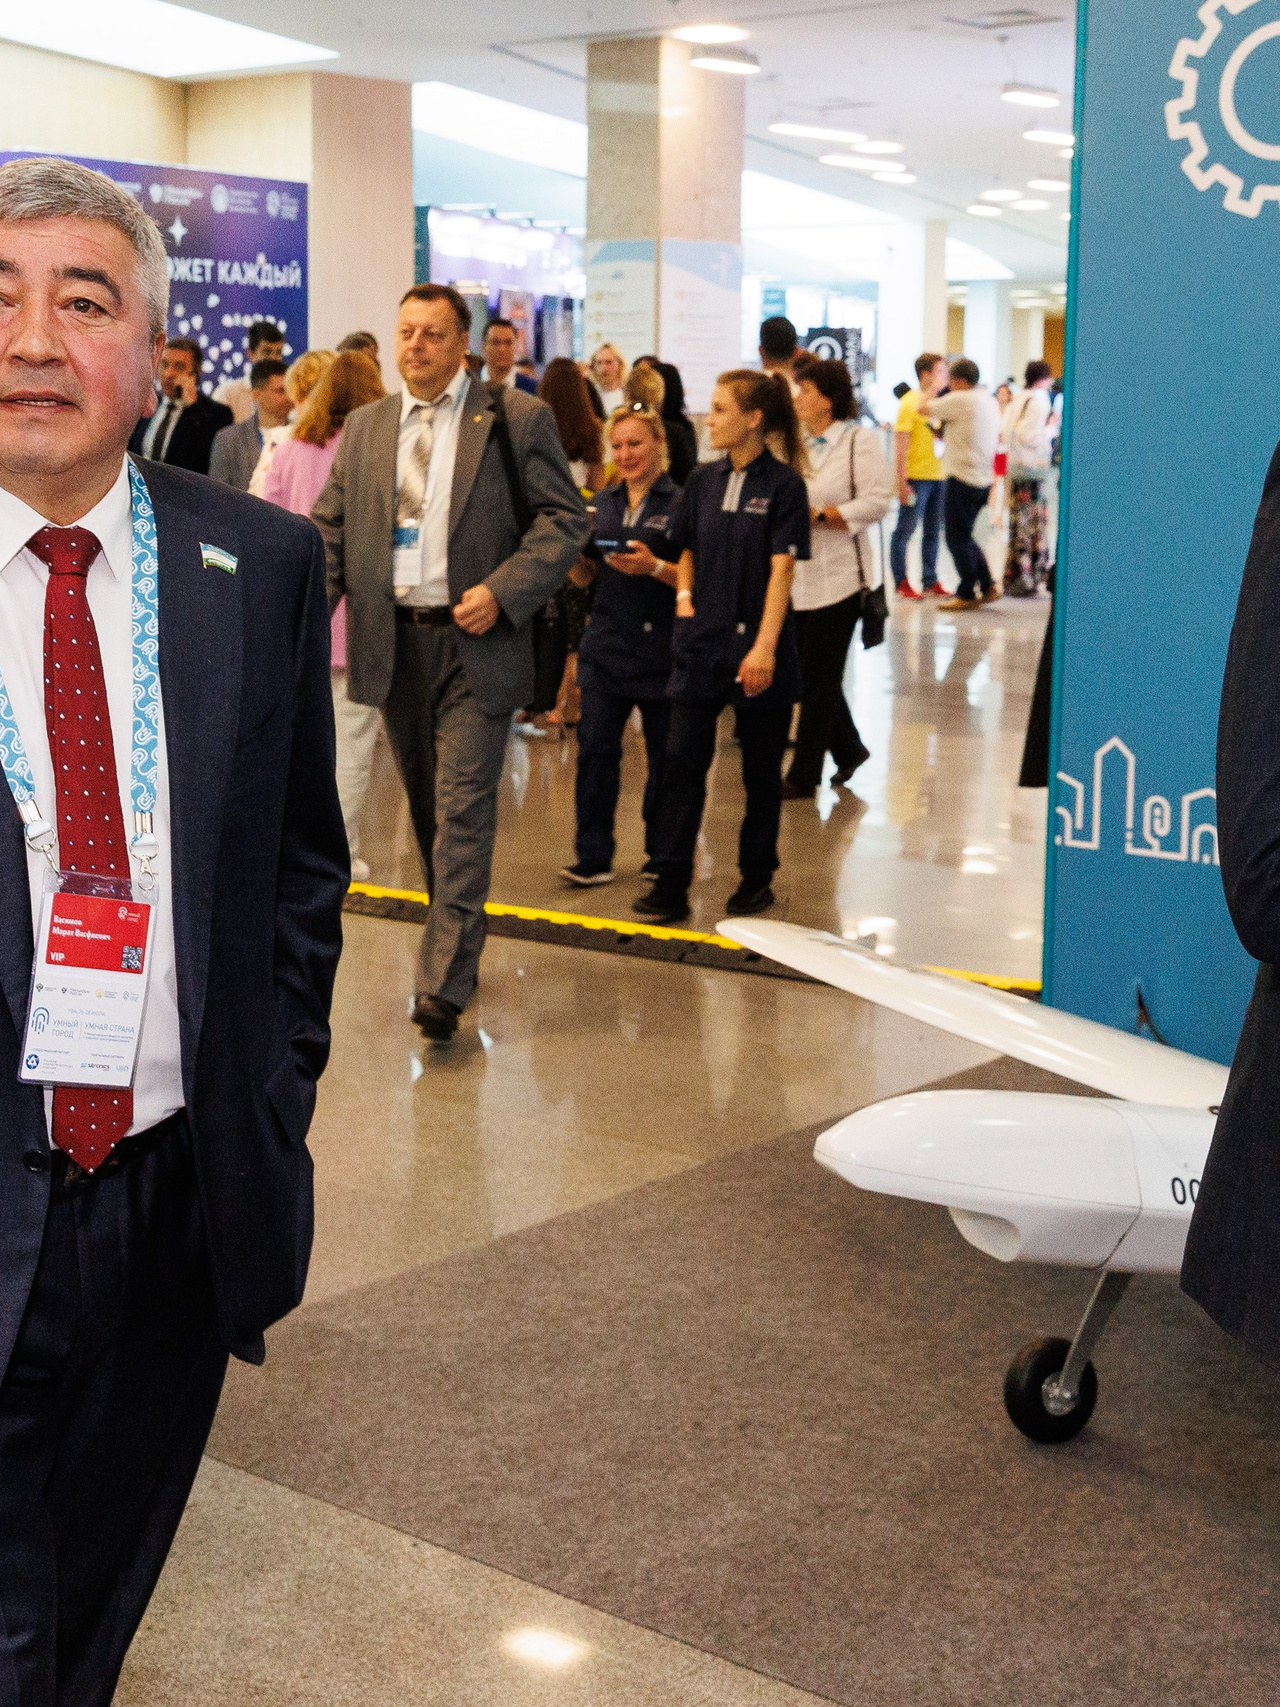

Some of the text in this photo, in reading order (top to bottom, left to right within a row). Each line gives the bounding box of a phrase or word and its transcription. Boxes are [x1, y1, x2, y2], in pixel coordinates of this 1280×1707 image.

[217, 259, 302, 290] КАЖДЫЙ
[50, 951, 66, 962] VIP
[52, 1019, 79, 1028] УМНЫЙ
[84, 1022, 135, 1033] УМНАЯ СТРАНА
[51, 1029, 74, 1039] ГОРОД
